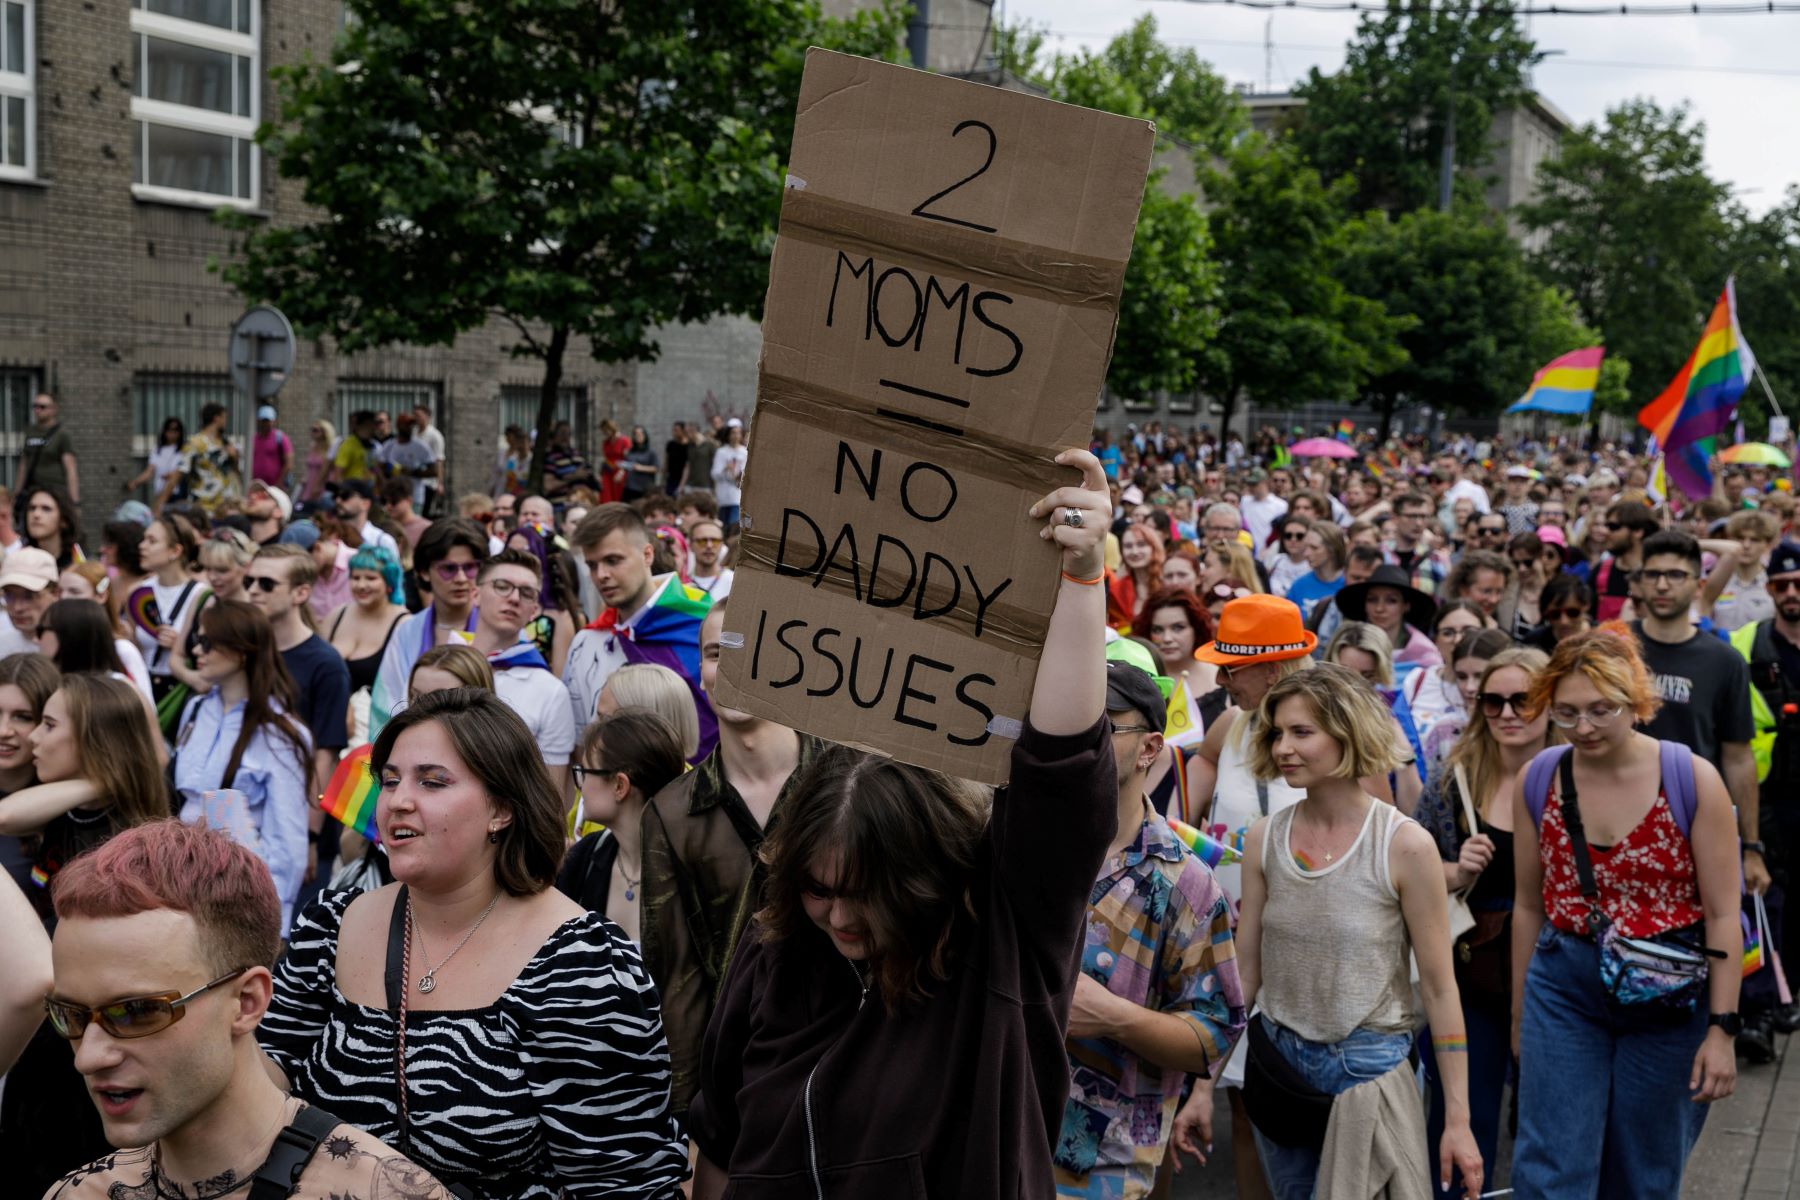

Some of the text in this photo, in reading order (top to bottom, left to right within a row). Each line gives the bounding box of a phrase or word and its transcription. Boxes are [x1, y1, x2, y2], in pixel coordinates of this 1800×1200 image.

[911, 120, 998, 233] 2
[826, 250, 1024, 378] MOMS
[833, 440, 958, 523] NO
[774, 507, 1013, 638] DADDY
[751, 609, 997, 747] ISSUES
[1221, 643, 1263, 654] LLORET
